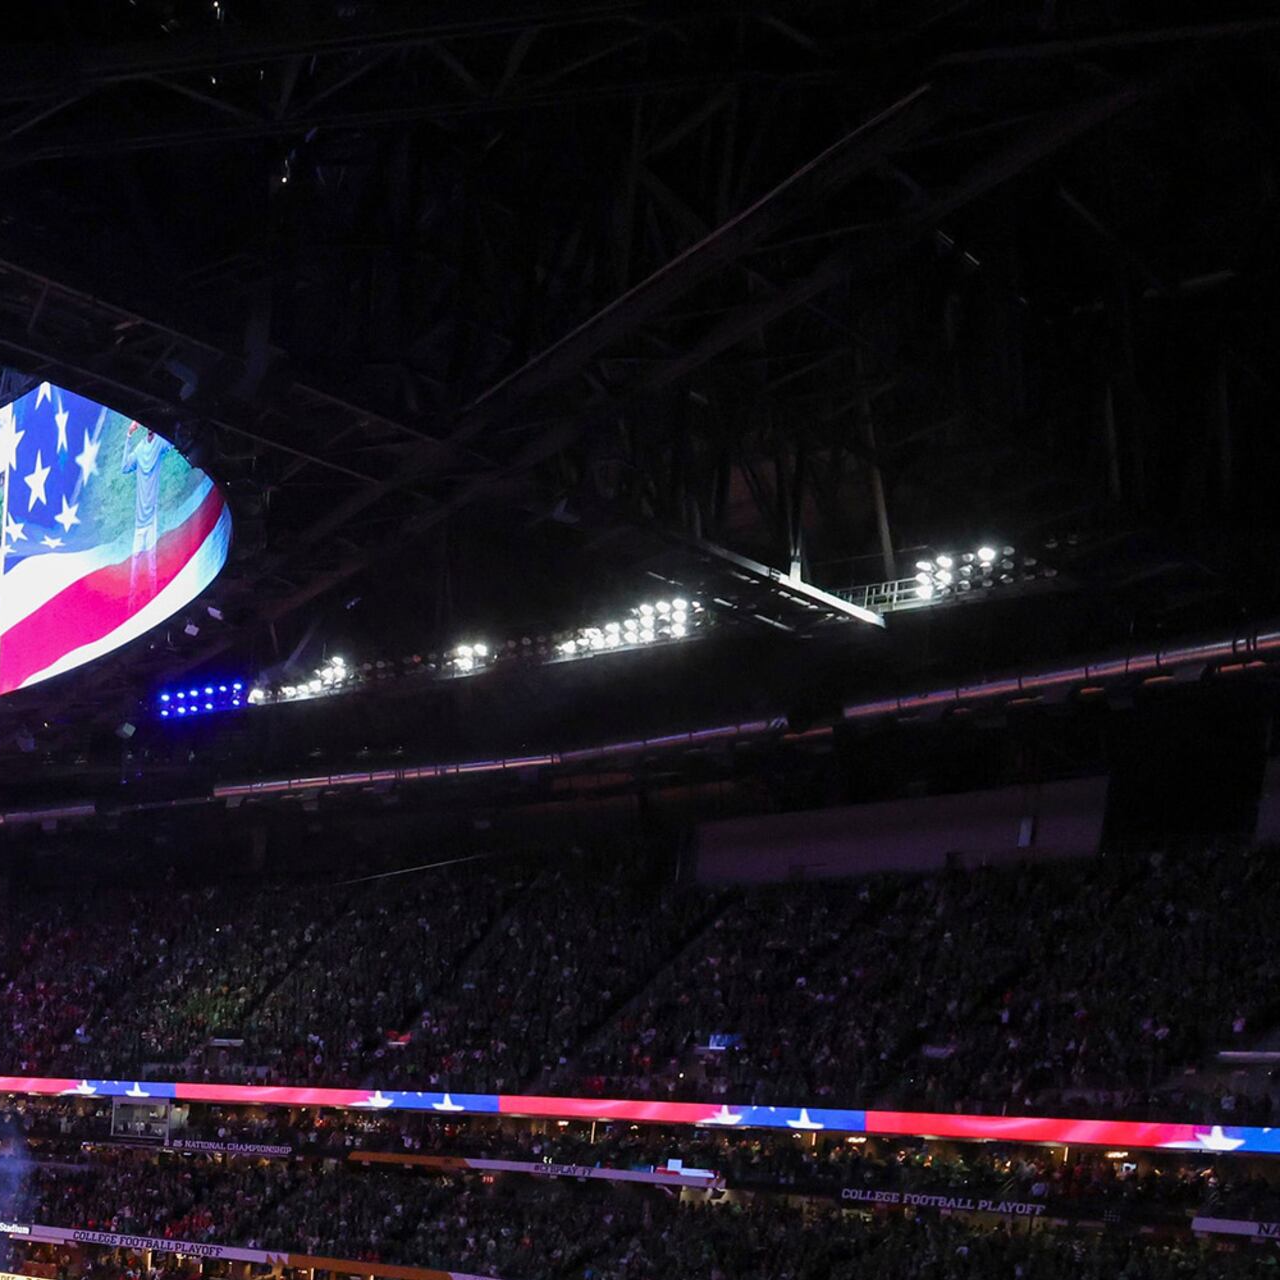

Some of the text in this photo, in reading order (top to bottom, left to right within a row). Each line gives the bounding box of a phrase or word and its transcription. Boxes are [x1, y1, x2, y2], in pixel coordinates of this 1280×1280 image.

[184, 1140, 226, 1151] NATIONAL
[226, 1142, 293, 1154] CHAMPIONSHIP
[841, 1188, 1046, 1216] COLLEGE FOOTBALL PLAYOFF
[73, 1230, 224, 1257] COLLEGE FOOTBALL PLAYOFF
